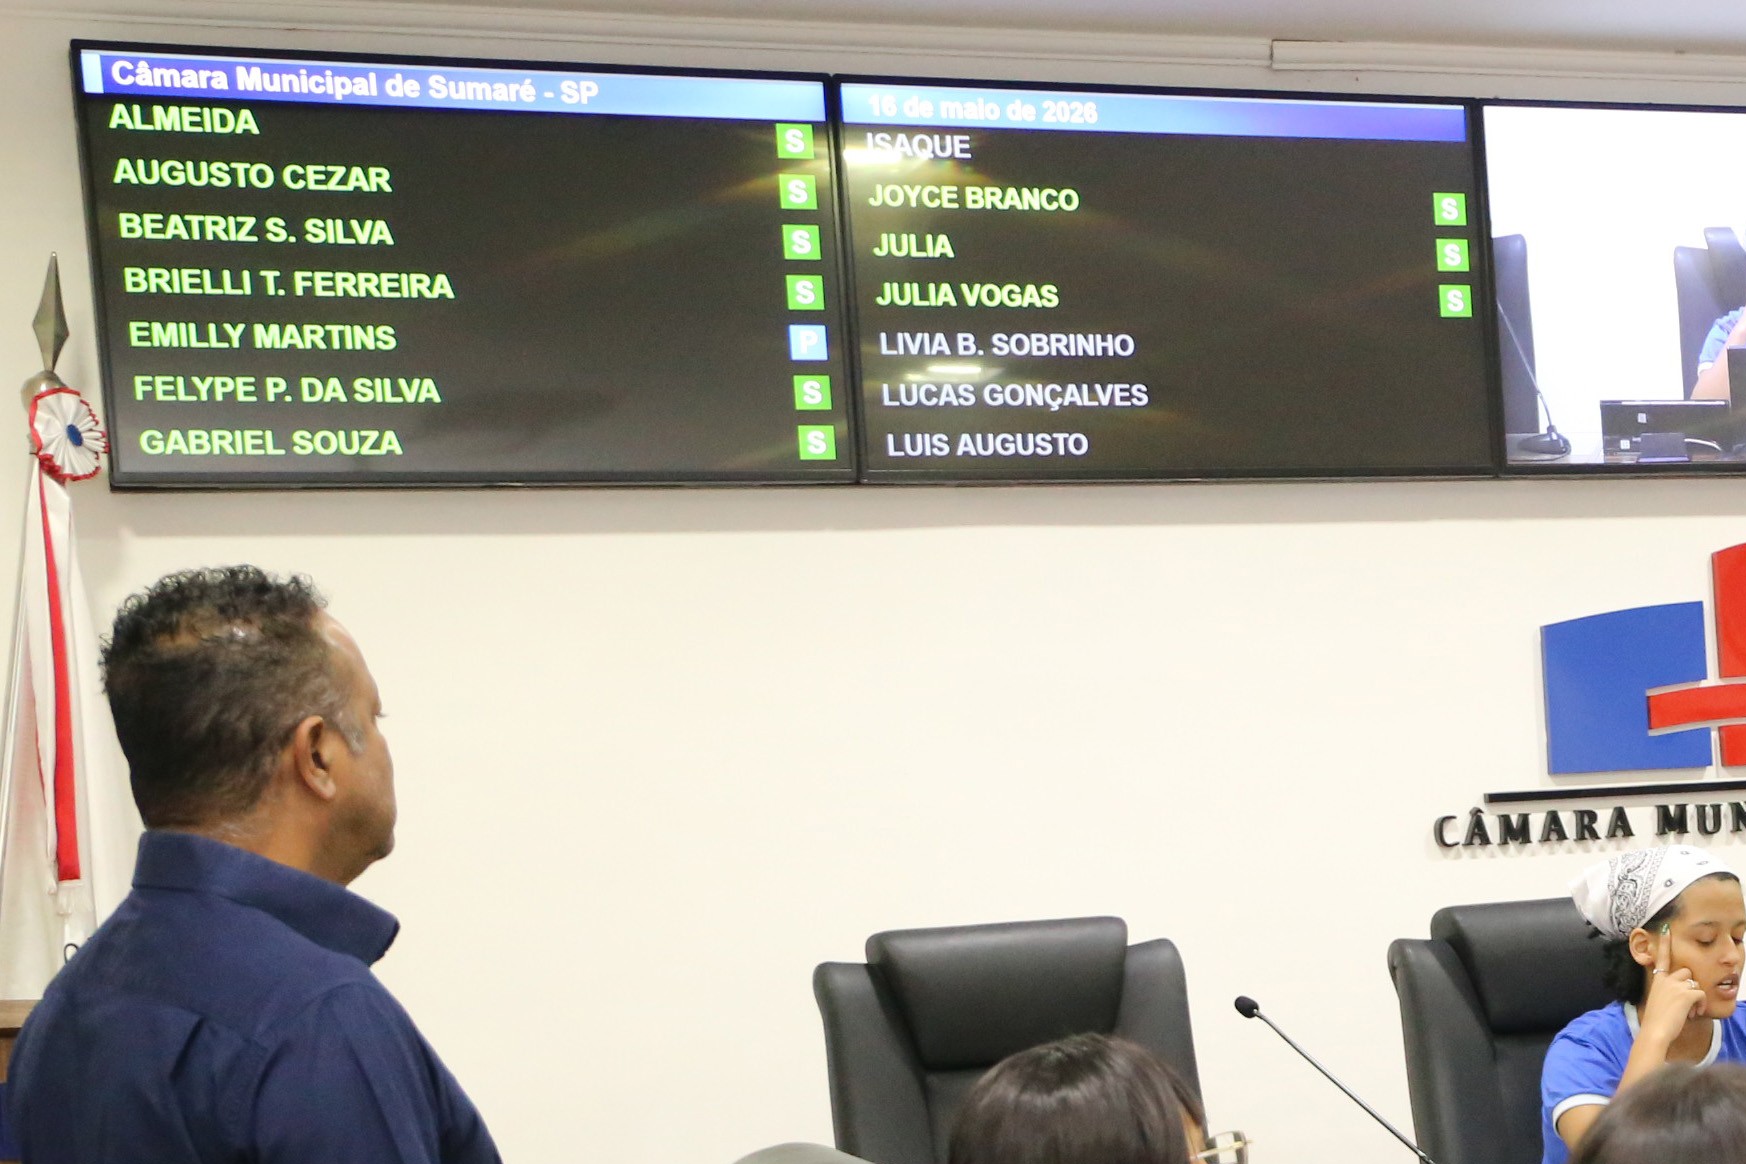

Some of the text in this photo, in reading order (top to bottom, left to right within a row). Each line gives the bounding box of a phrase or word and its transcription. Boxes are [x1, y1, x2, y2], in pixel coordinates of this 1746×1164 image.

[111, 61, 229, 91] Câmara
[237, 65, 378, 98] Municipal
[389, 72, 420, 98] de
[428, 73, 536, 102] Sumaré
[561, 80, 599, 105] SP
[109, 104, 259, 134] ALMEIDA
[869, 96, 1098, 123] 16 de maio de 2026
[785, 129, 804, 152] S
[867, 132, 972, 159] ISAQUE
[113, 158, 392, 192] AUGUSTO CEZAR
[788, 180, 808, 204] S
[869, 184, 1079, 211] JOYCE BRANCO
[1442, 198, 1457, 220] S
[119, 213, 394, 245] BEATRIZ S. SILVA
[791, 231, 811, 254] S
[873, 234, 954, 258] JULIA
[1444, 244, 1461, 266] S
[124, 267, 455, 299] BRIELLI T. FERREIRA
[796, 281, 815, 304] S
[876, 282, 1059, 307] JULIA VOGAS
[1447, 290, 1463, 312] S
[129, 322, 396, 350] EMILLY MARTINS
[800, 332, 818, 354] P
[880, 332, 1134, 356] LIVIA B. SOBRINHO
[134, 376, 441, 403] FELYPE P. DA SILVA
[802, 381, 822, 405] S
[882, 382, 1149, 412] LUCAS GONÇALVES
[140, 430, 403, 458] GABRIEL SOUZA
[807, 431, 827, 455] S
[887, 433, 1088, 456] LUIS AUGUSTO
[1434, 806, 1634, 849] CÂMARA
